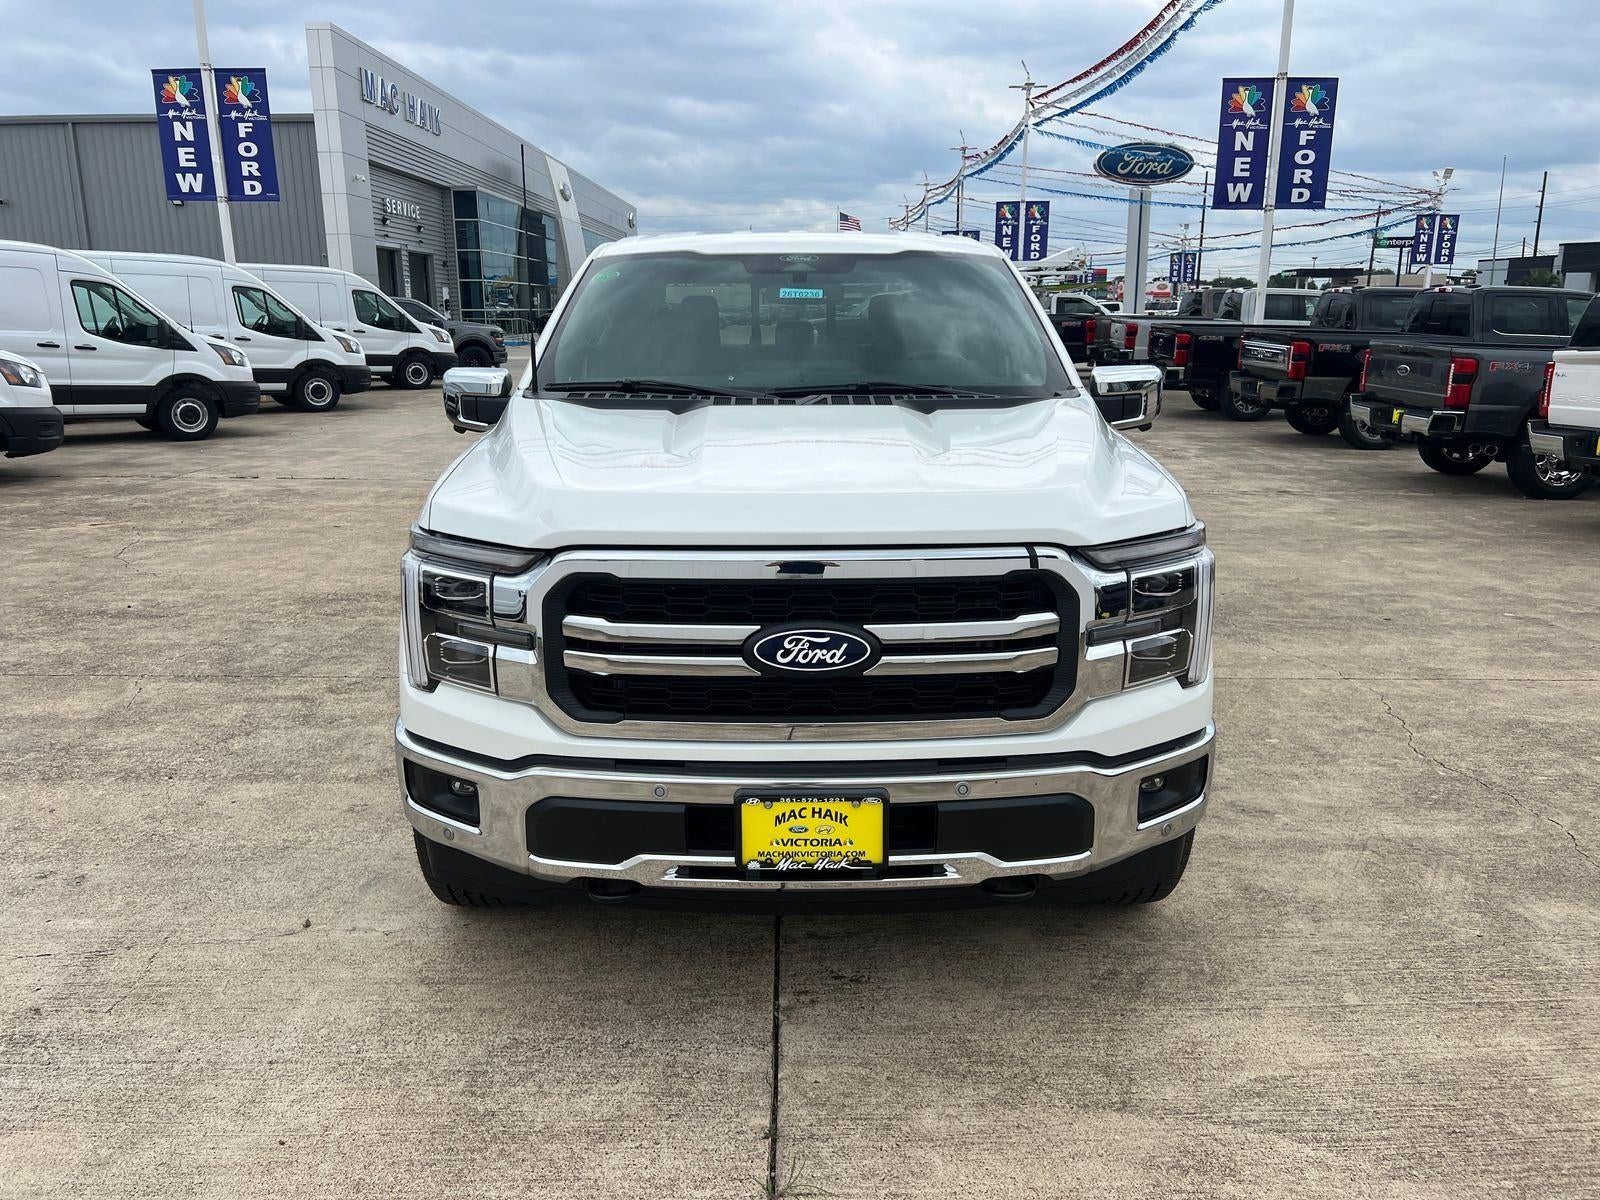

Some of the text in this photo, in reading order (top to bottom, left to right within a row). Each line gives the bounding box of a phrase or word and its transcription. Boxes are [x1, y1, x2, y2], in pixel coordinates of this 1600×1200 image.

[360, 67, 441, 136] MAC HAIK
[172, 121, 203, 193] NEW
[237, 122, 263, 196] FORD
[1117, 150, 1173, 175] Ford
[1226, 131, 1255, 203] NEW
[1290, 130, 1317, 203] FORD
[386, 198, 421, 219] SERVICE
[1030, 225, 1041, 260] FORD
[1416, 234, 1428, 262] NEW
[1440, 234, 1451, 263] FORD
[1171, 264, 1179, 282] NEW
[1318, 343, 1352, 353] FX4
[1489, 361, 1532, 372] FX4
[776, 635, 849, 664] Ford
[774, 806, 849, 827] MAC HAIK
[757, 850, 866, 858] MACHAIKVICTORIA.COM
[780, 838, 843, 847] VICTORIA
[775, 857, 851, 871] Mac Haik
